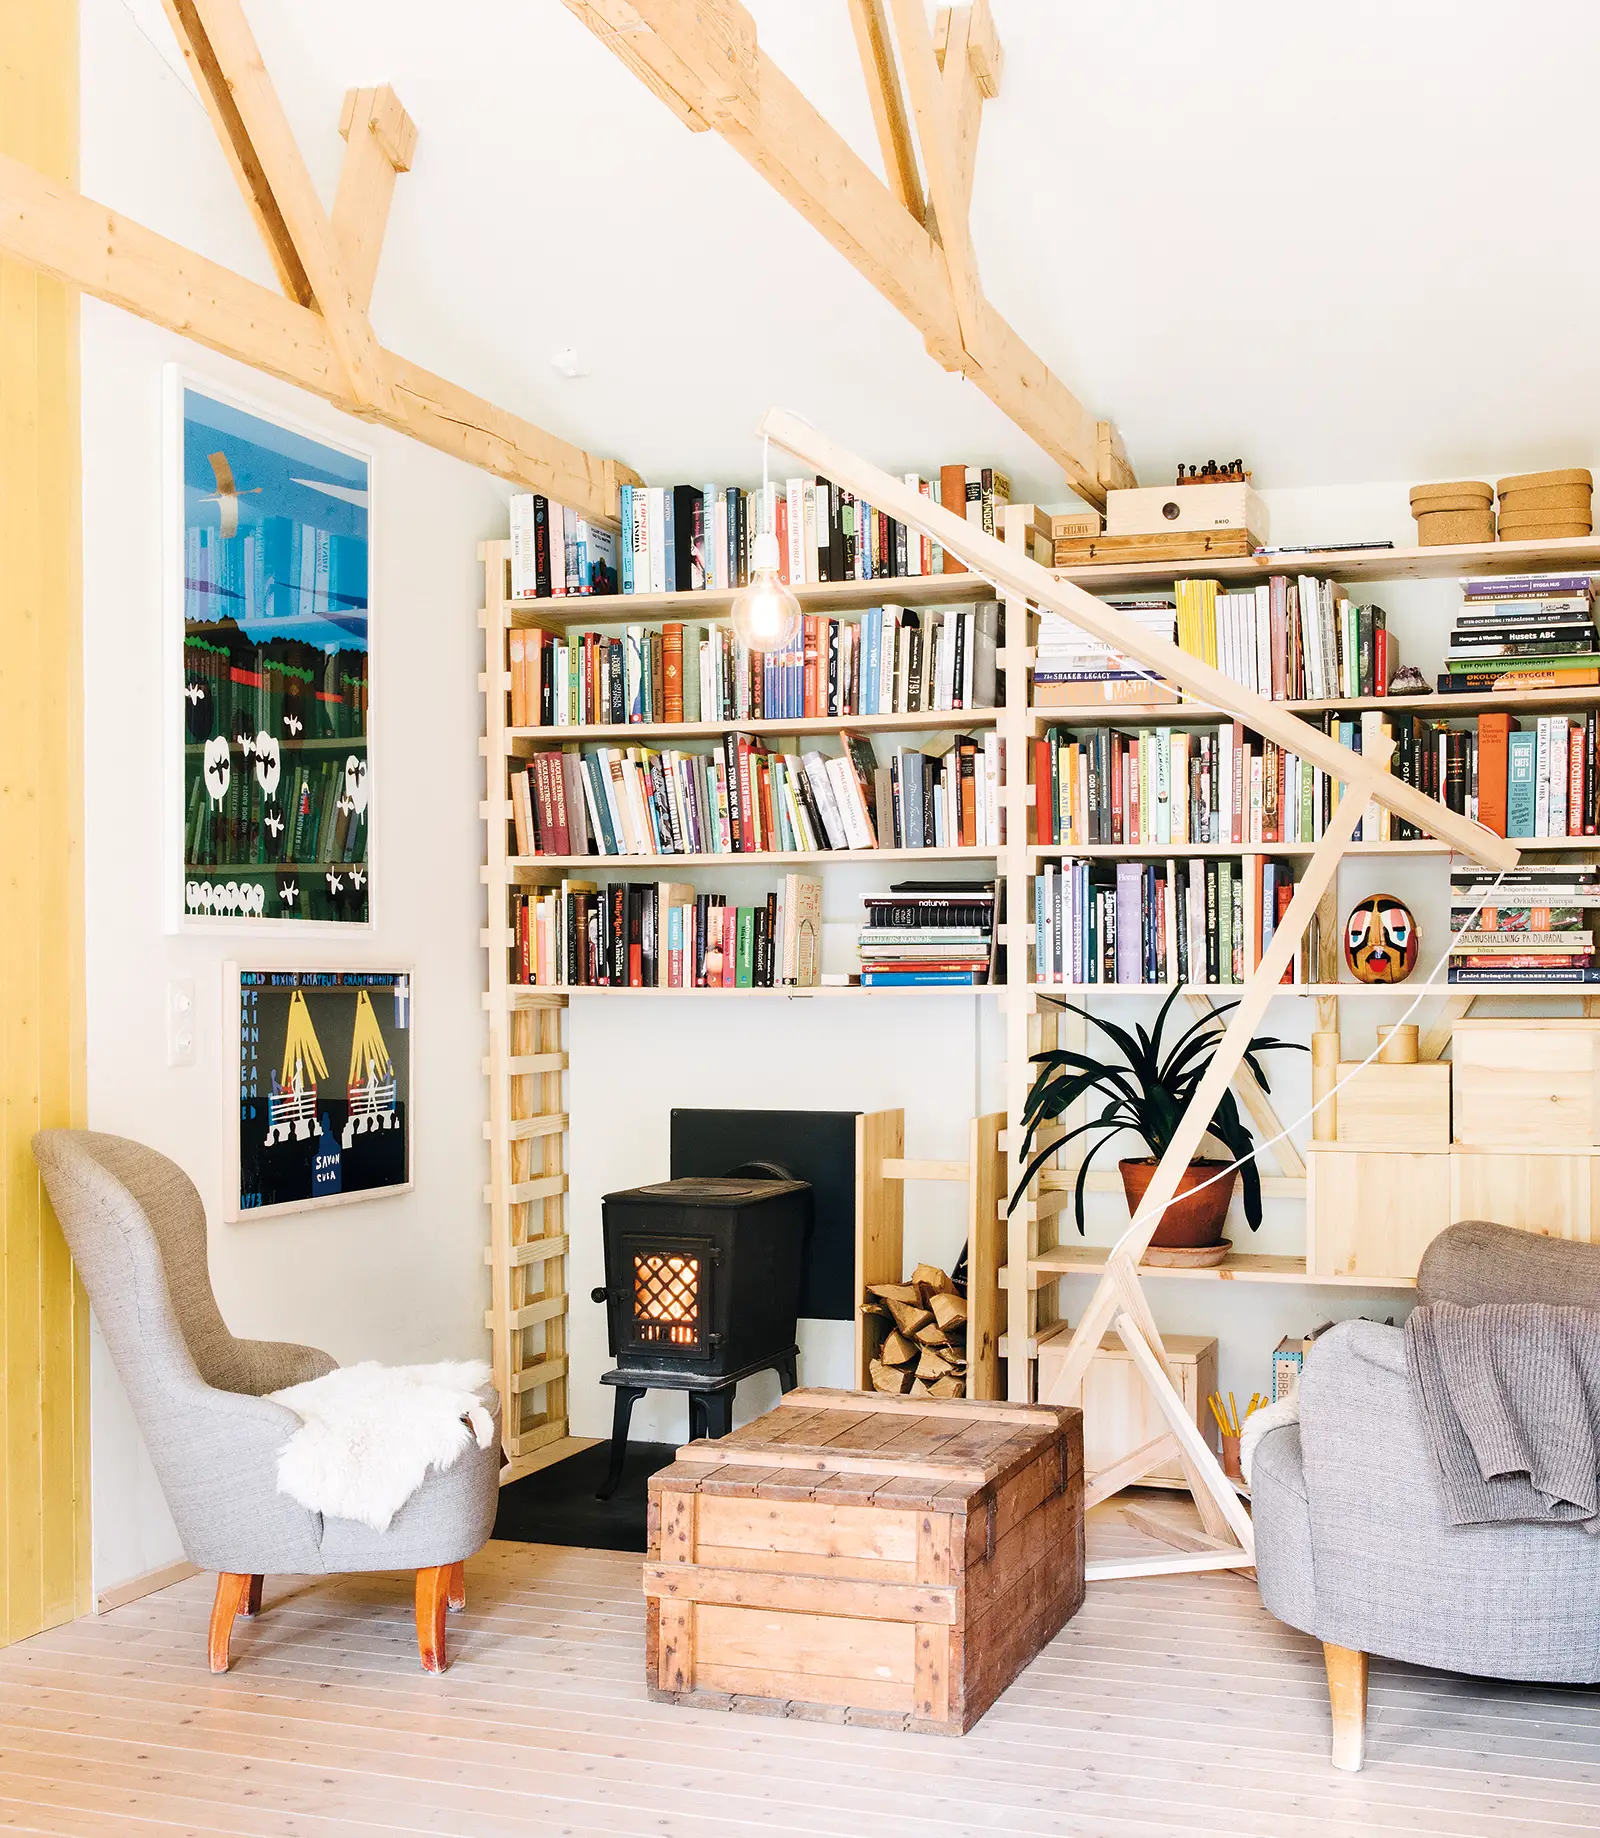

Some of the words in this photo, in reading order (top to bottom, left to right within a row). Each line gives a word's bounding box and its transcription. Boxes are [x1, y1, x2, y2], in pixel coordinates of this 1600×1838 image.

[791, 490, 799, 509] KING
[792, 510, 799, 520] OF
[982, 488, 994, 536] STRINDBER
[537, 526, 545, 551] Homo
[792, 521, 800, 537] THE
[1063, 525, 1089, 535] BELLMAN
[537, 552, 545, 573] Deus
[1539, 631, 1556, 639] ABC
[804, 634, 818, 667] PEAK
[869, 648, 878, 667] YOGI
[908, 675, 921, 695] 1793
[1053, 672, 1082, 680] SHAKER
[1084, 672, 1111, 680] LEGACY
[1518, 671, 1555, 679] BYGGERI
[1513, 748, 1530, 757] WHERE
[1514, 758, 1529, 767] CHEFS
[1539, 749, 1547, 770] WITH
[1572, 745, 1582, 763] GOTT
[541, 758, 550, 784] AUGUST
[553, 758, 563, 784] AUGUST
[663, 768, 672, 793] DYLAN
[728, 767, 736, 790] STORA
[739, 751, 750, 795] TROTSBOKEN
[1572, 763, 1582, 778] OCH
[1062, 782, 1068, 793] NU
[1088, 774, 1096, 788] GOD
[1571, 779, 1581, 802] BILLIGT
[729, 791, 738, 806] BOK
[1088, 789, 1097, 811] KAFFE
[1302, 777, 1311, 806] 2015
[544, 784, 553, 828] STRINDBERG
[556, 784, 566, 827] STRINDBERG
[730, 807, 739, 819] OM
[1571, 808, 1580, 829] PARIS
[731, 820, 740, 839] BARN
[1208, 872, 1216, 908] RUNÅBERGS
[614, 889, 623, 916] Philip
[1221, 900, 1229, 919] LILLA
[1263, 889, 1273, 933] ÄGODELA
[1548, 897, 1574, 906] Europa
[613, 916, 623, 937] Roth
[1208, 909, 1216, 929] FRÖER
[1073, 914, 1081, 976] PERENNER
[1533, 933, 1564, 943] DJUPADAL
[614, 940, 622, 977] Amerika
[316, 1153, 340, 1170] SAVON
[317, 1171, 336, 1183] CUBA
